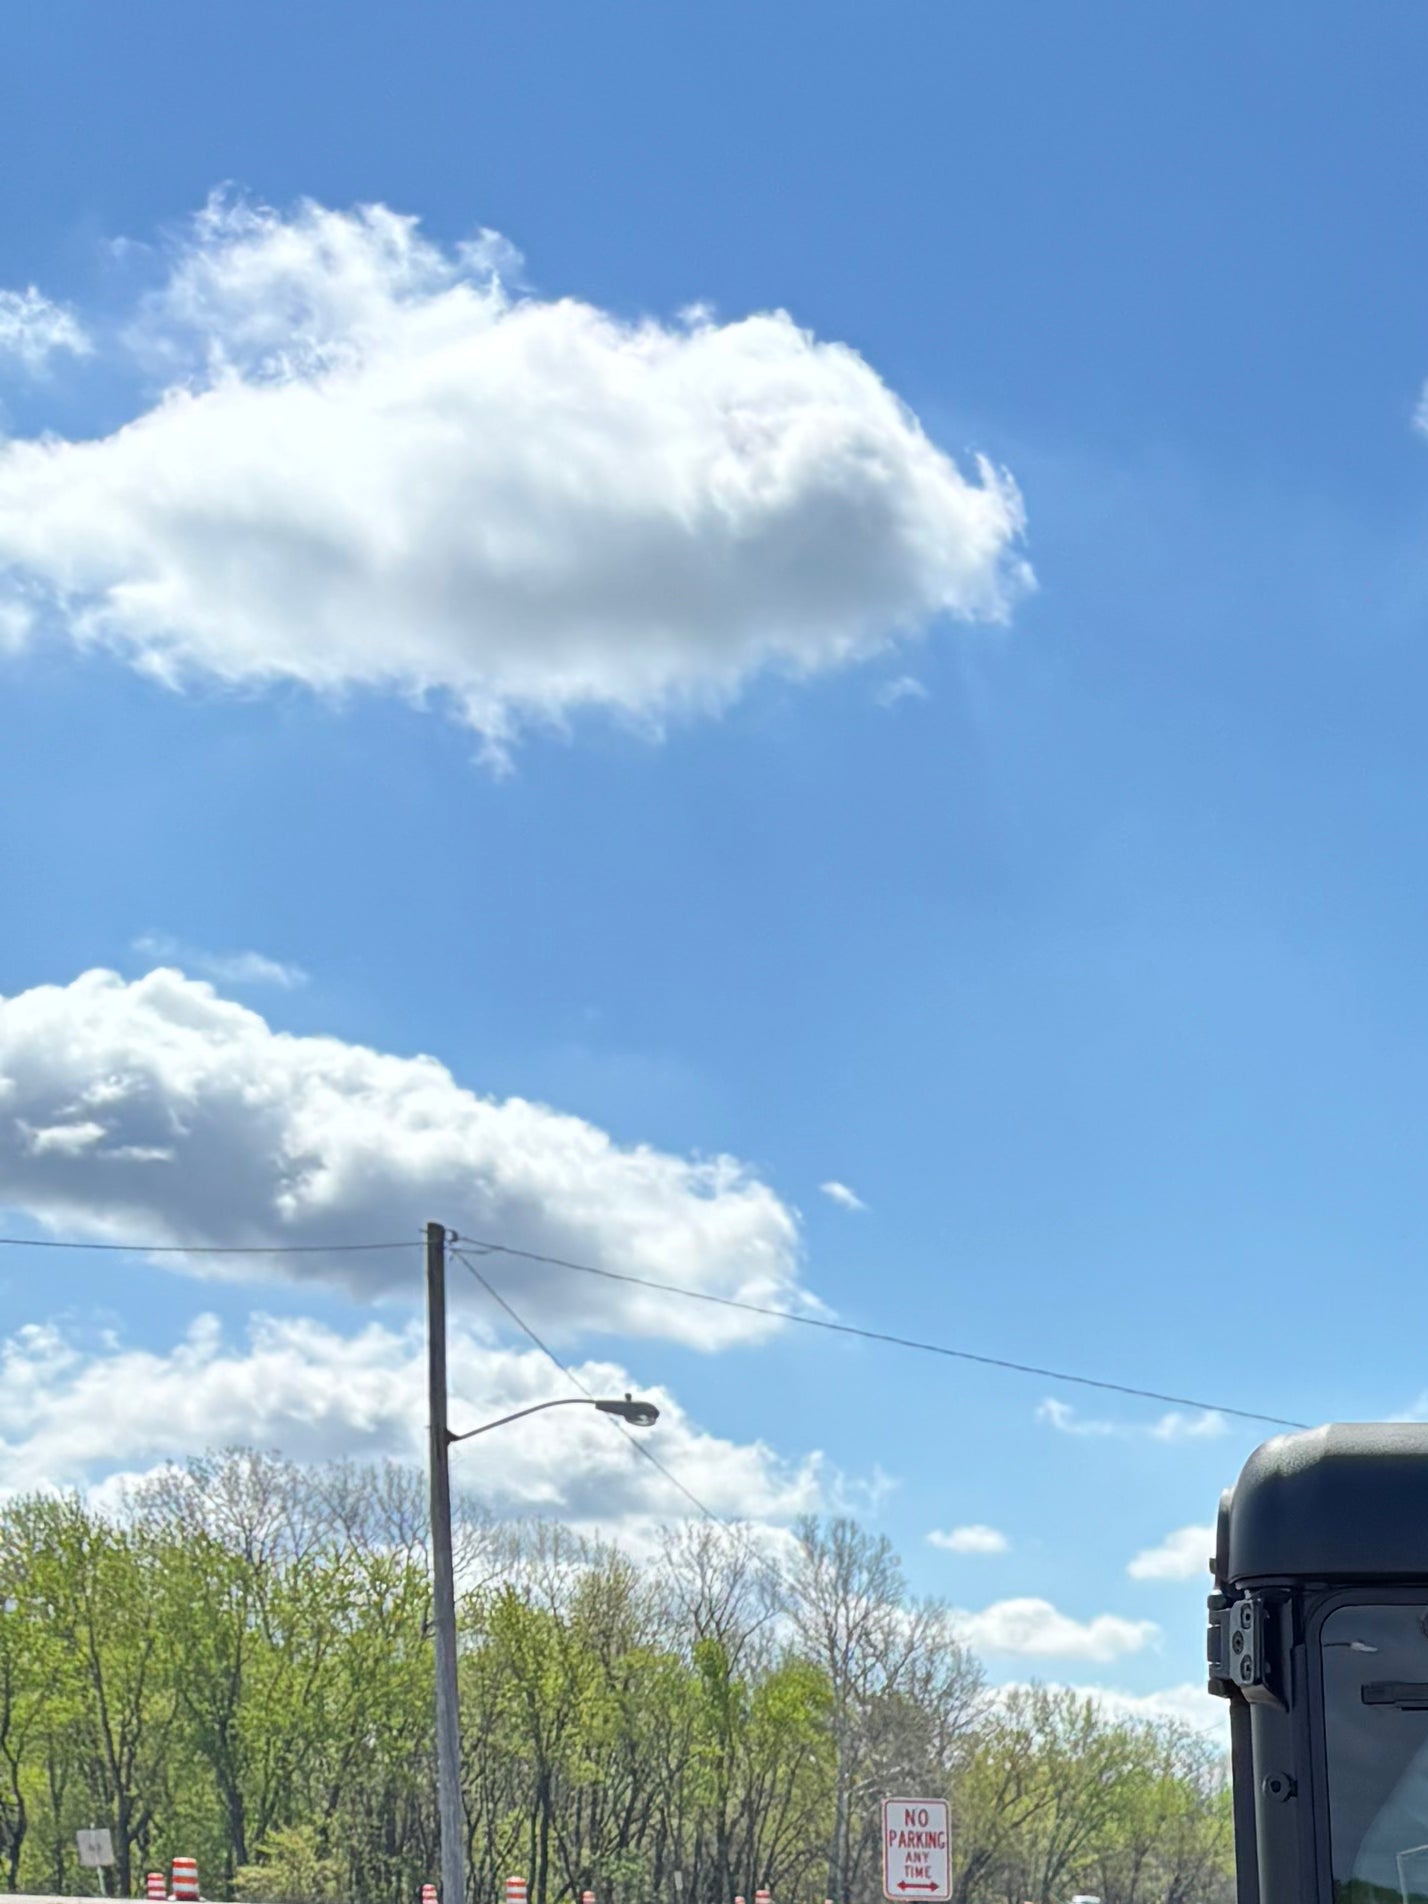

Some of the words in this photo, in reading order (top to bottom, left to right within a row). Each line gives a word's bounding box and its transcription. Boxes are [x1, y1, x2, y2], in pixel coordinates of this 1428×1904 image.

[904, 1808, 929, 1828] NO
[889, 1829, 946, 1850] PARKING
[905, 1851, 929, 1863] ANY
[904, 1865, 932, 1879] TIME
